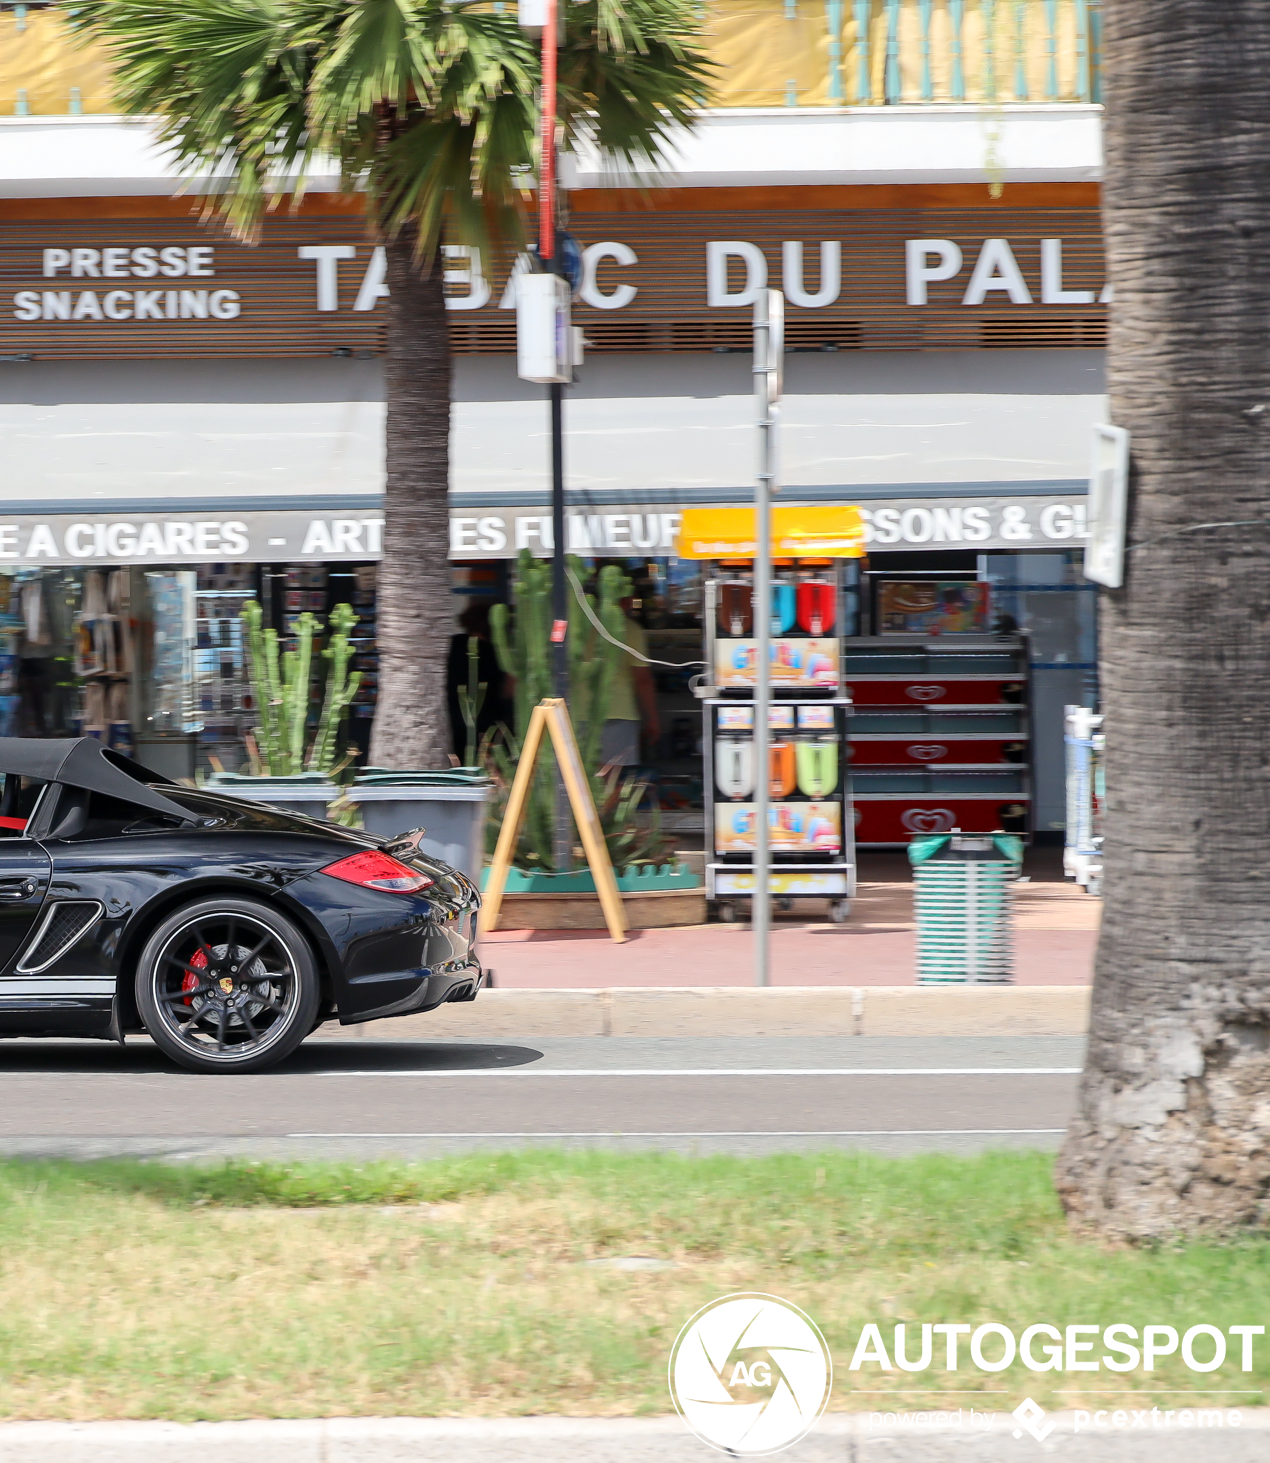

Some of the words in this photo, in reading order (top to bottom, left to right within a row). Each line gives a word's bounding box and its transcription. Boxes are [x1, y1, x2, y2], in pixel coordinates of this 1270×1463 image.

[42, 246, 215, 278] PRESSE
[706, 240, 842, 308] DU
[904, 238, 1113, 306] PAL
[12, 289, 242, 321] SNACKING
[24, 524, 61, 558] A
[63, 520, 250, 558] CIGARES
[998, 505, 1034, 540] &
